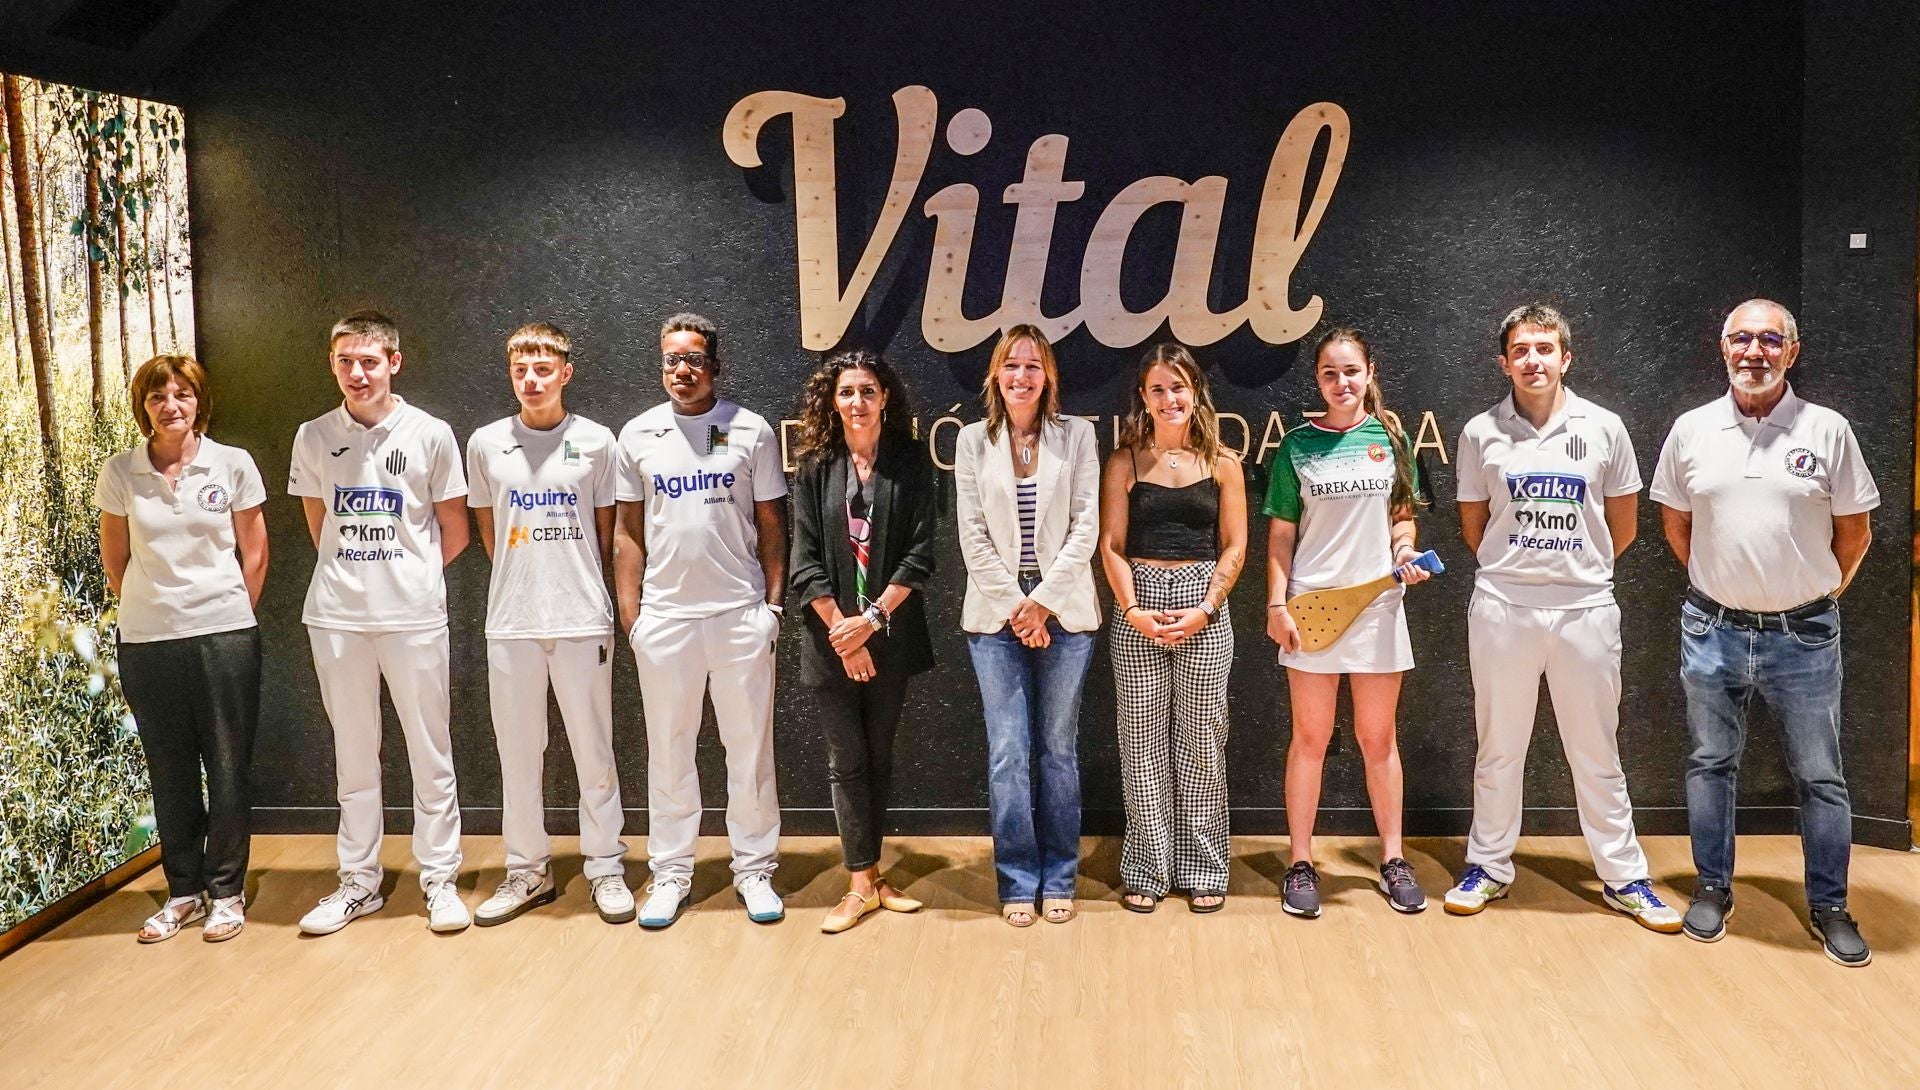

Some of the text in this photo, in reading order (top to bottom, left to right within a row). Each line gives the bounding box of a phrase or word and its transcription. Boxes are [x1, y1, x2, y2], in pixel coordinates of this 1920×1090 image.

[722, 85, 1351, 353] Vital
[653, 469, 736, 498] Aguirre
[1310, 479, 1390, 497] ERREKALEOR
[1514, 477, 1580, 500] Kaiku
[337, 491, 397, 513] Kaiku
[510, 488, 577, 510] Aguirre
[704, 496, 726, 505] Allianz
[1535, 511, 1577, 531] Km0
[359, 524, 396, 541] Km0
[532, 527, 583, 541] CEPIAL
[1519, 535, 1572, 550] Recalvi
[345, 548, 393, 561] Recalvi
